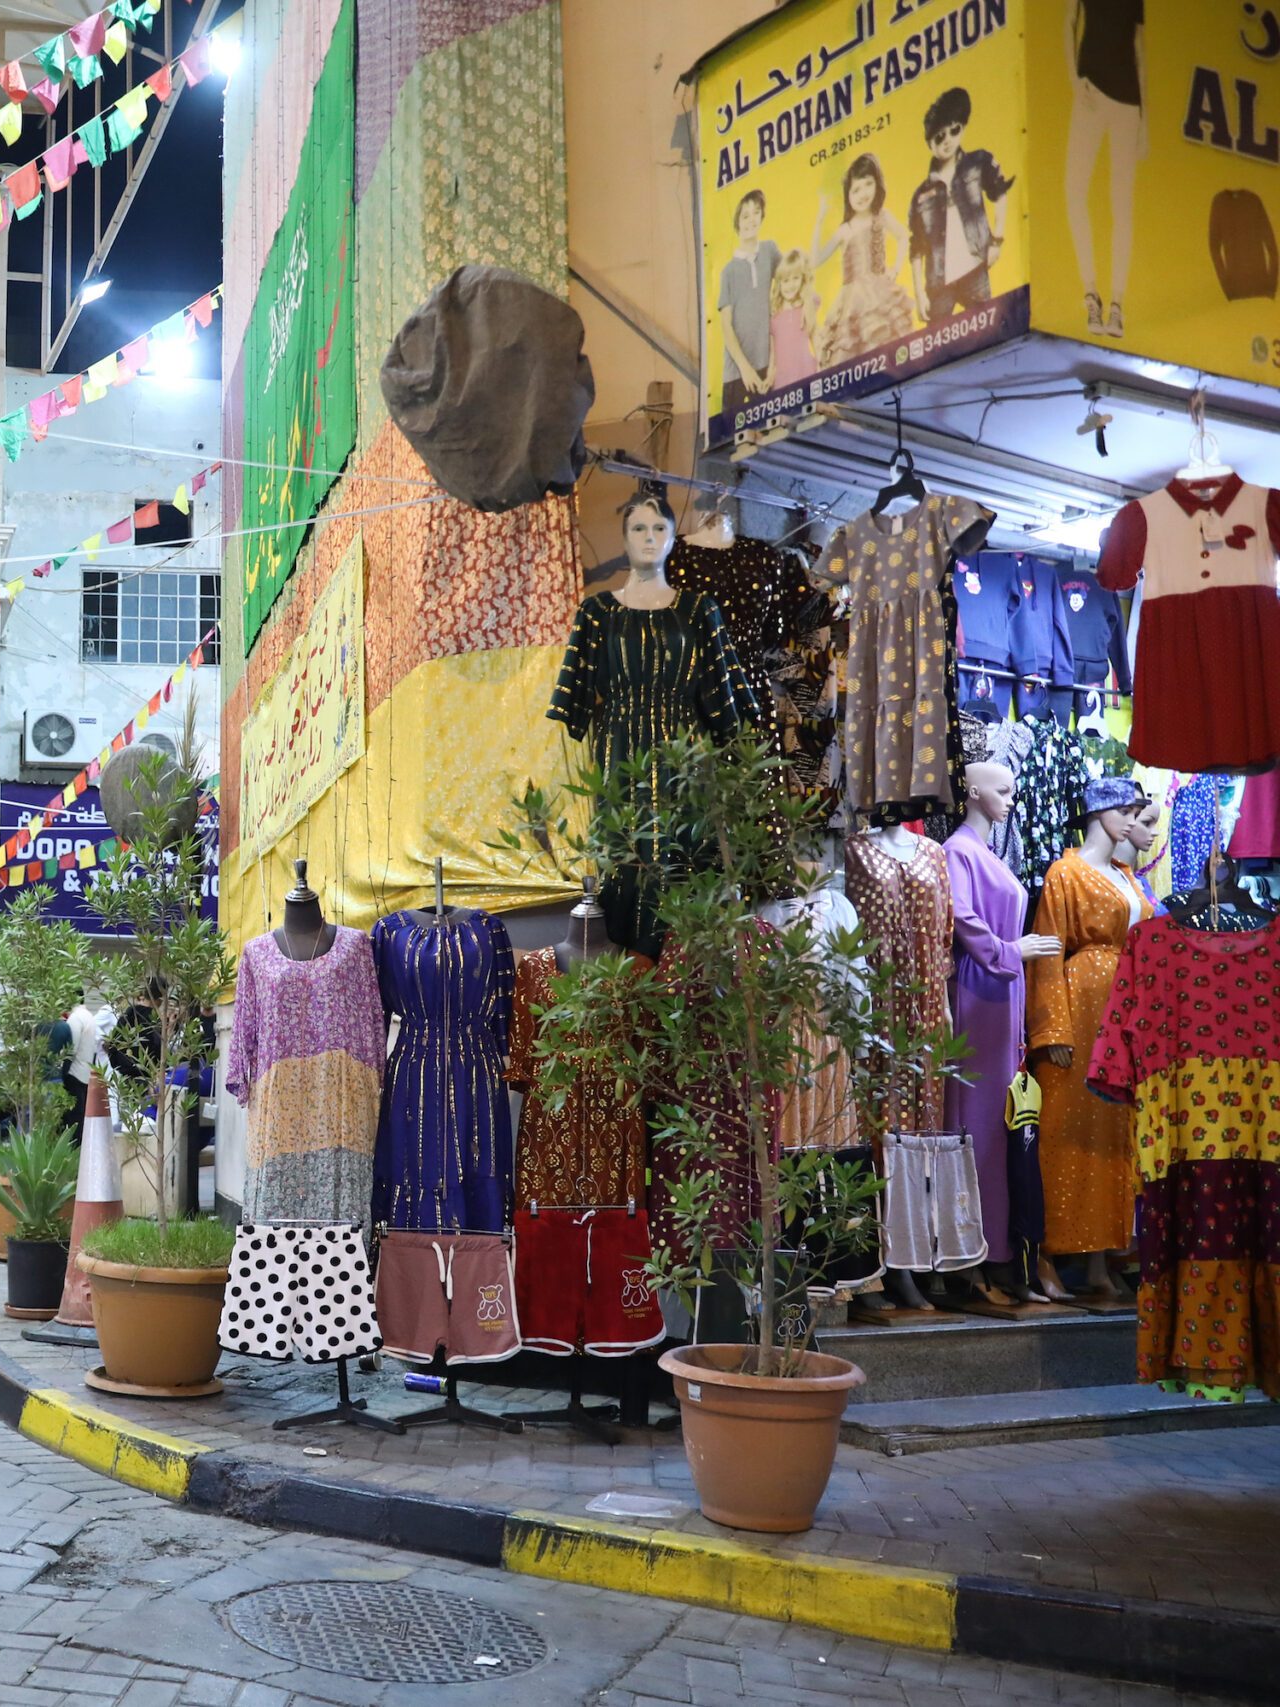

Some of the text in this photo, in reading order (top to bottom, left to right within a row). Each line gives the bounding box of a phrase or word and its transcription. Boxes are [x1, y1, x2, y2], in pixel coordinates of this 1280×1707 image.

[717, 0, 1006, 187] AL ROHAN FASHION
[1183, 66, 1279, 163] AL
[745, 307, 997, 425] 33793488 33710722 34380497
